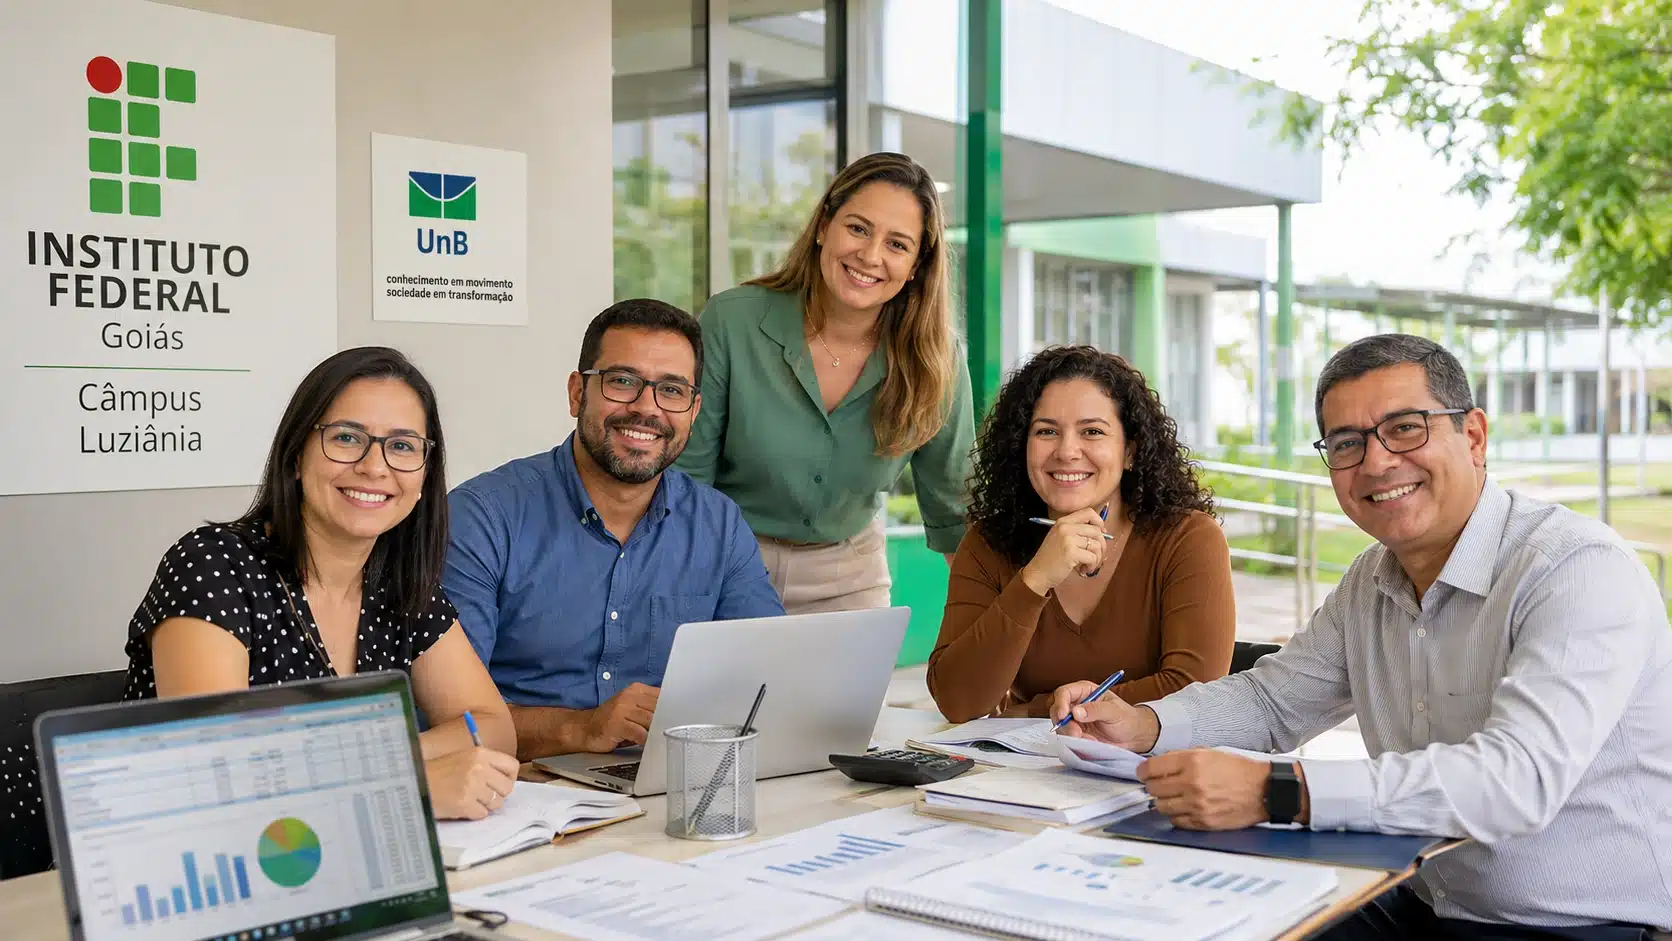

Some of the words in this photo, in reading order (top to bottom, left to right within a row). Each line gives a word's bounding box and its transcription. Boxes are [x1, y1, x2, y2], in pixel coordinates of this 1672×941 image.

[28, 231, 249, 277] INSTITUTO
[417, 228, 468, 255] UnB
[49, 273, 231, 313] FEDERAL
[386, 273, 449, 287] conhecimento
[450, 278, 464, 287] em
[465, 278, 514, 289] movimento
[386, 286, 432, 299] sociedade
[433, 290, 447, 299] em
[448, 289, 514, 304] transformação
[101, 321, 184, 350] Goiás
[78, 382, 203, 419] Câmpus
[80, 424, 203, 454] Luziânia
